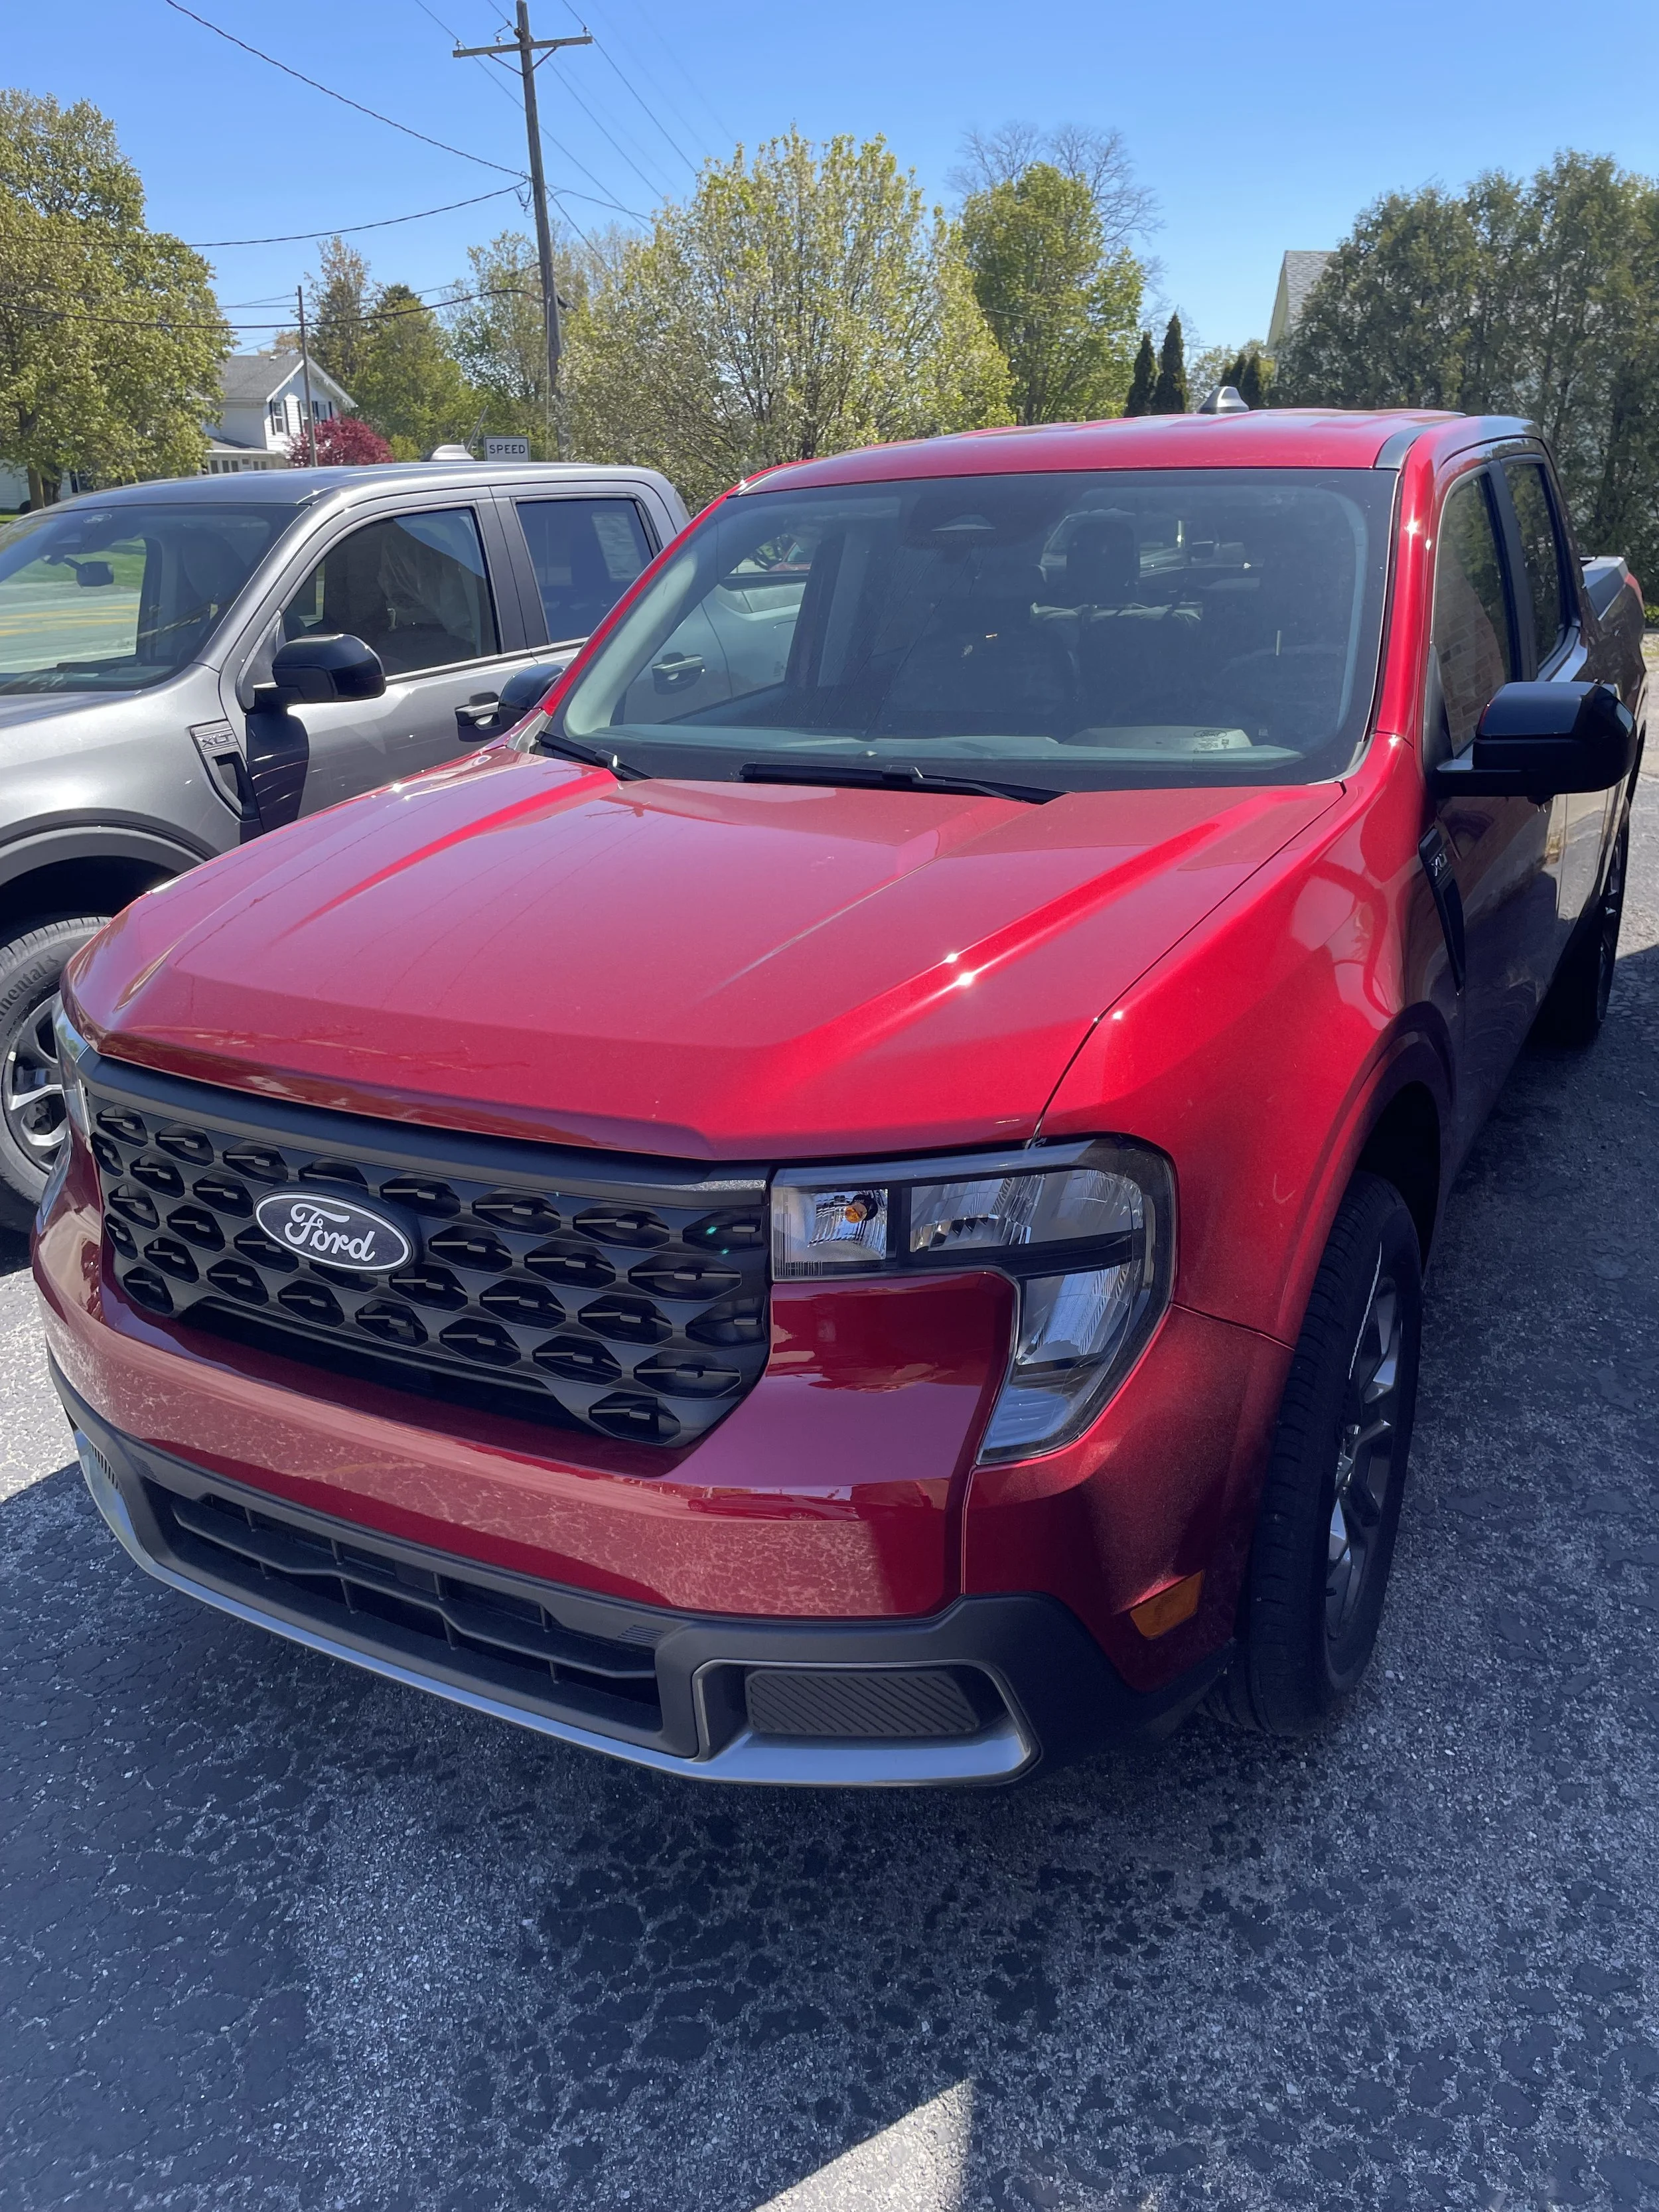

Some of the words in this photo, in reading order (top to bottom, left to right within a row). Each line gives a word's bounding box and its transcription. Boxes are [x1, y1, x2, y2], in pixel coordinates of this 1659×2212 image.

[489, 445, 526, 454] SPEED
[199, 733, 233, 747] XLT
[0, 961, 48, 1016] nental
[285, 1203, 376, 1262] Ford
